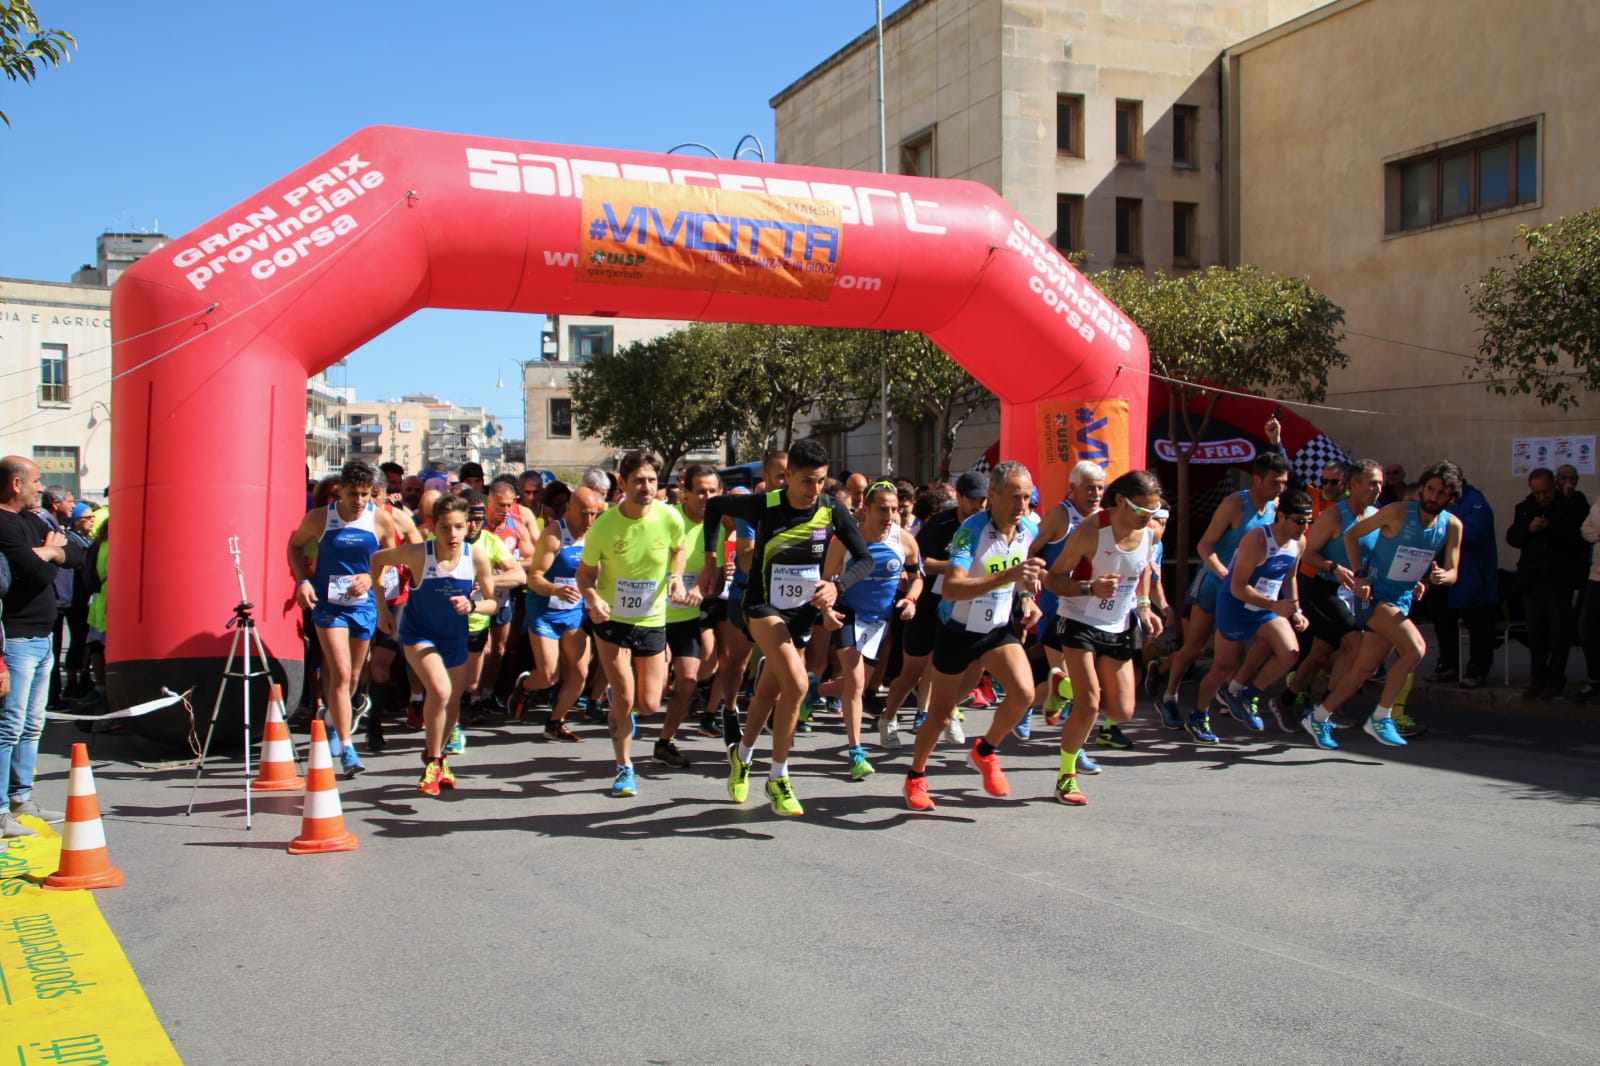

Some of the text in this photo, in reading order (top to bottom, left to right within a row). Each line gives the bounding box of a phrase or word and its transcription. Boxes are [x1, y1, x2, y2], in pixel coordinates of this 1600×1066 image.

[172, 153, 371, 268] GRAN PRIX
[185, 170, 384, 291] provinciale
[250, 213, 360, 280] corsa
[607, 252, 646, 266] UISP
[805, 262, 835, 274] GIOCO
[1006, 230, 1131, 352] provinciale
[1028, 275, 1096, 344] corsa
[31, 313, 40, 323] E
[1057, 427, 1068, 463] UISP
[1402, 562, 1411, 573] 2
[778, 584, 803, 598] 139
[620, 596, 642, 608] 120
[1099, 598, 1115, 611] 88
[984, 608, 993, 622] 9
[0, 914, 96, 999] sportpertutti
